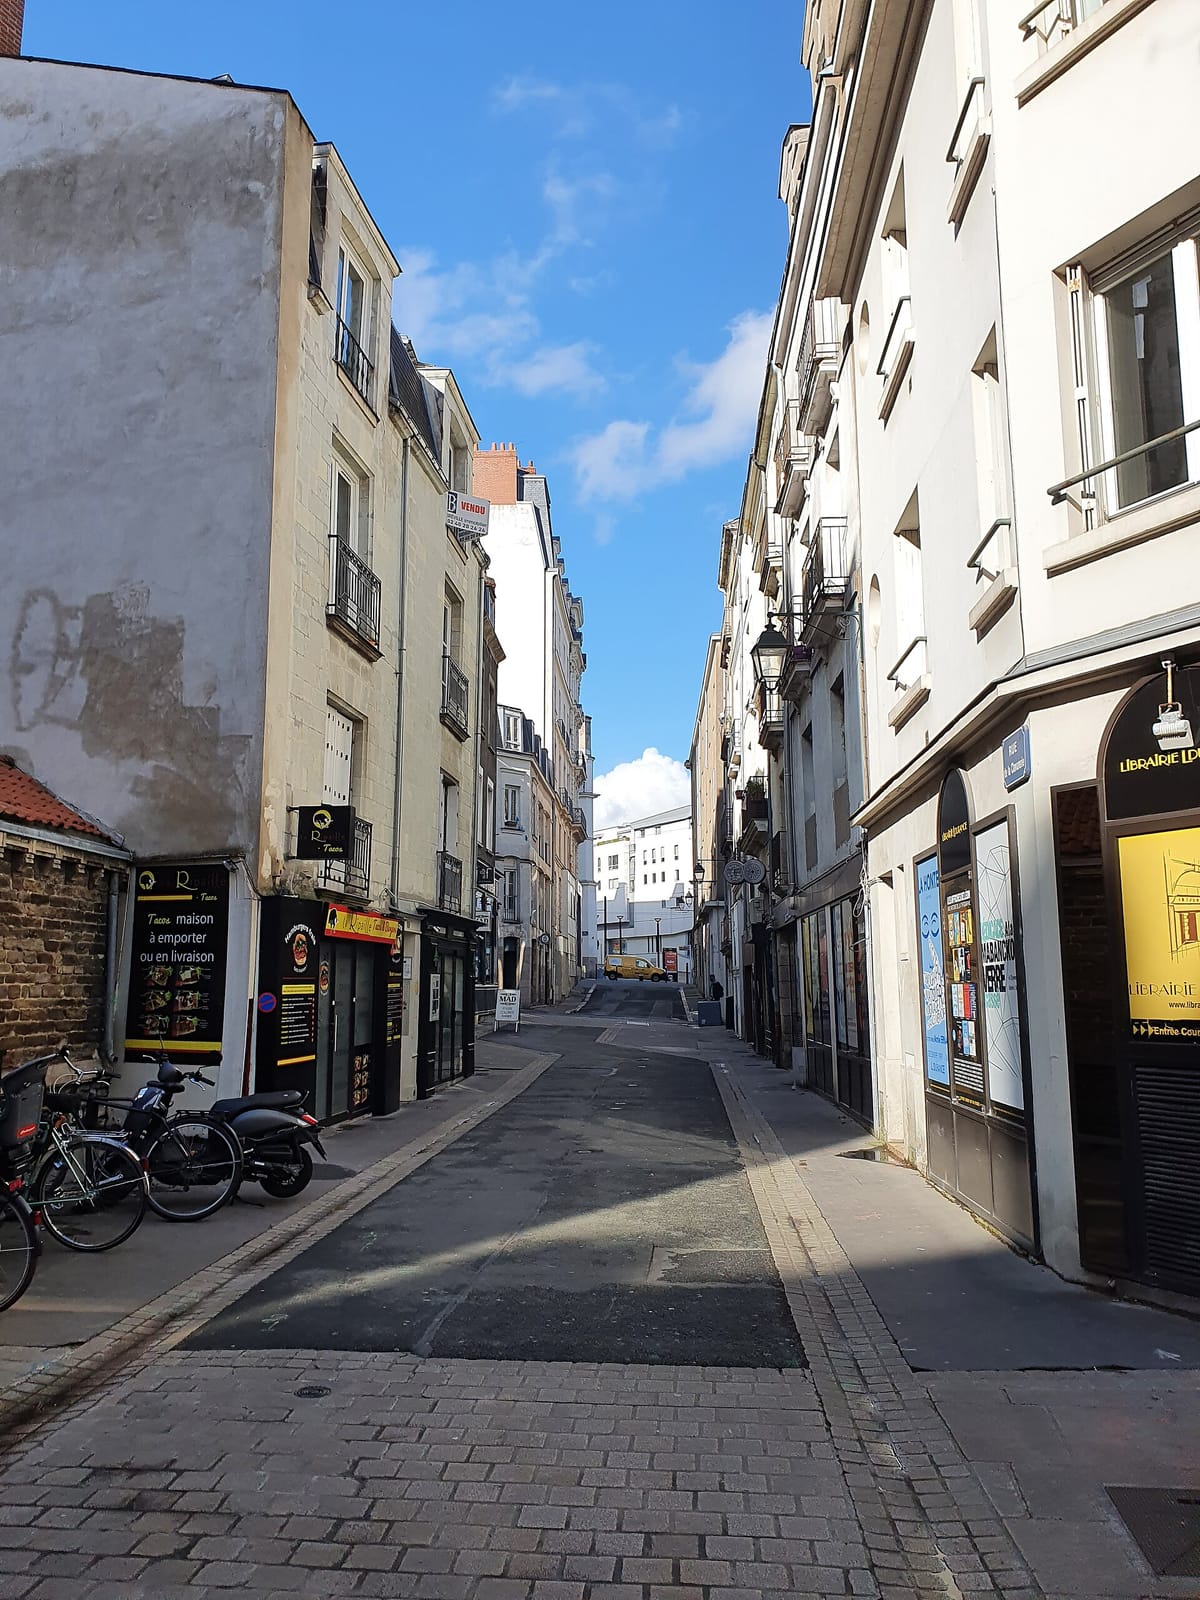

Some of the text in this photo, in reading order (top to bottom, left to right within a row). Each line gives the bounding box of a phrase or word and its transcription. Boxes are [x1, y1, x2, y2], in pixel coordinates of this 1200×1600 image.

[461, 501, 485, 514] VENDU
[1120, 752, 1179, 773] LIBRAIRIE
[147, 912, 214, 926] Tacos maison
[149, 931, 207, 946] à emporter
[140, 949, 215, 962] ou en livraison
[499, 995, 517, 1003] MAD
